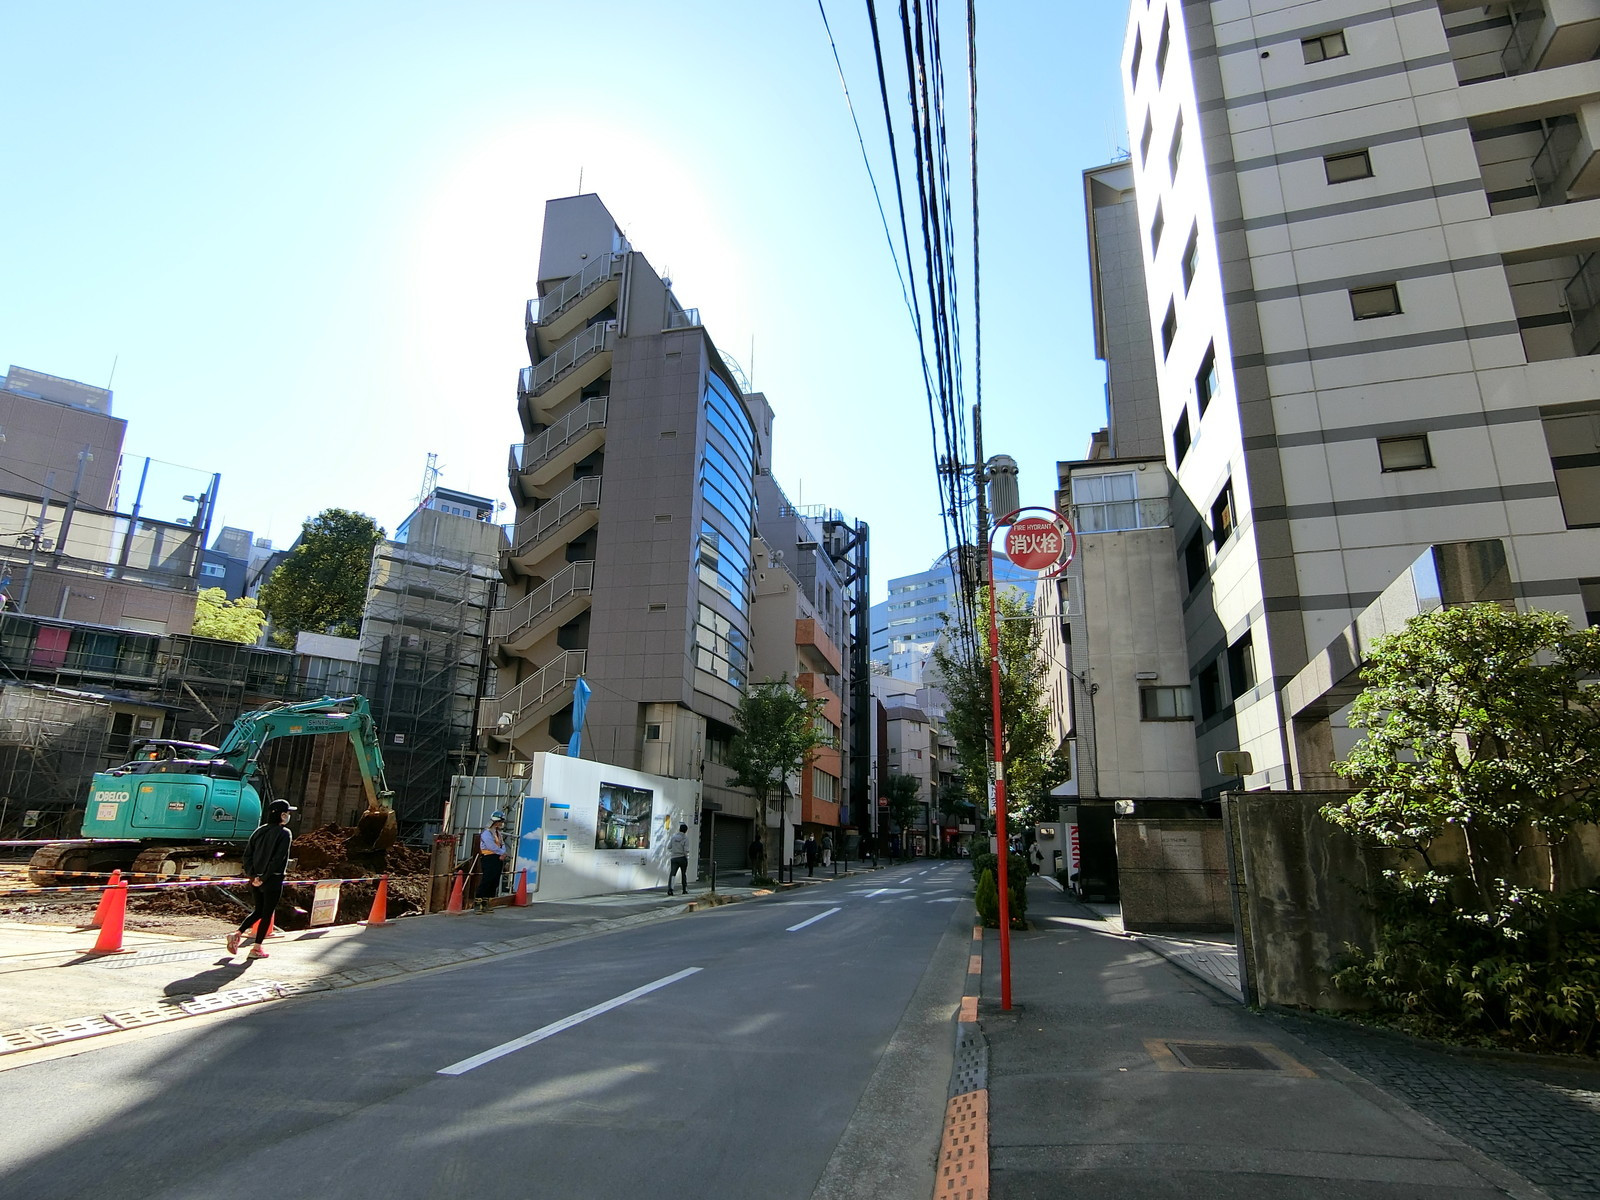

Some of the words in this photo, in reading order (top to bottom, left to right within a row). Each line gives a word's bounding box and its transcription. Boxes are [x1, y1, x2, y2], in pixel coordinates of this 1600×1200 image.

[1010, 532, 1058, 554] 消火栓
[94, 791, 129, 803] KOBELCO
